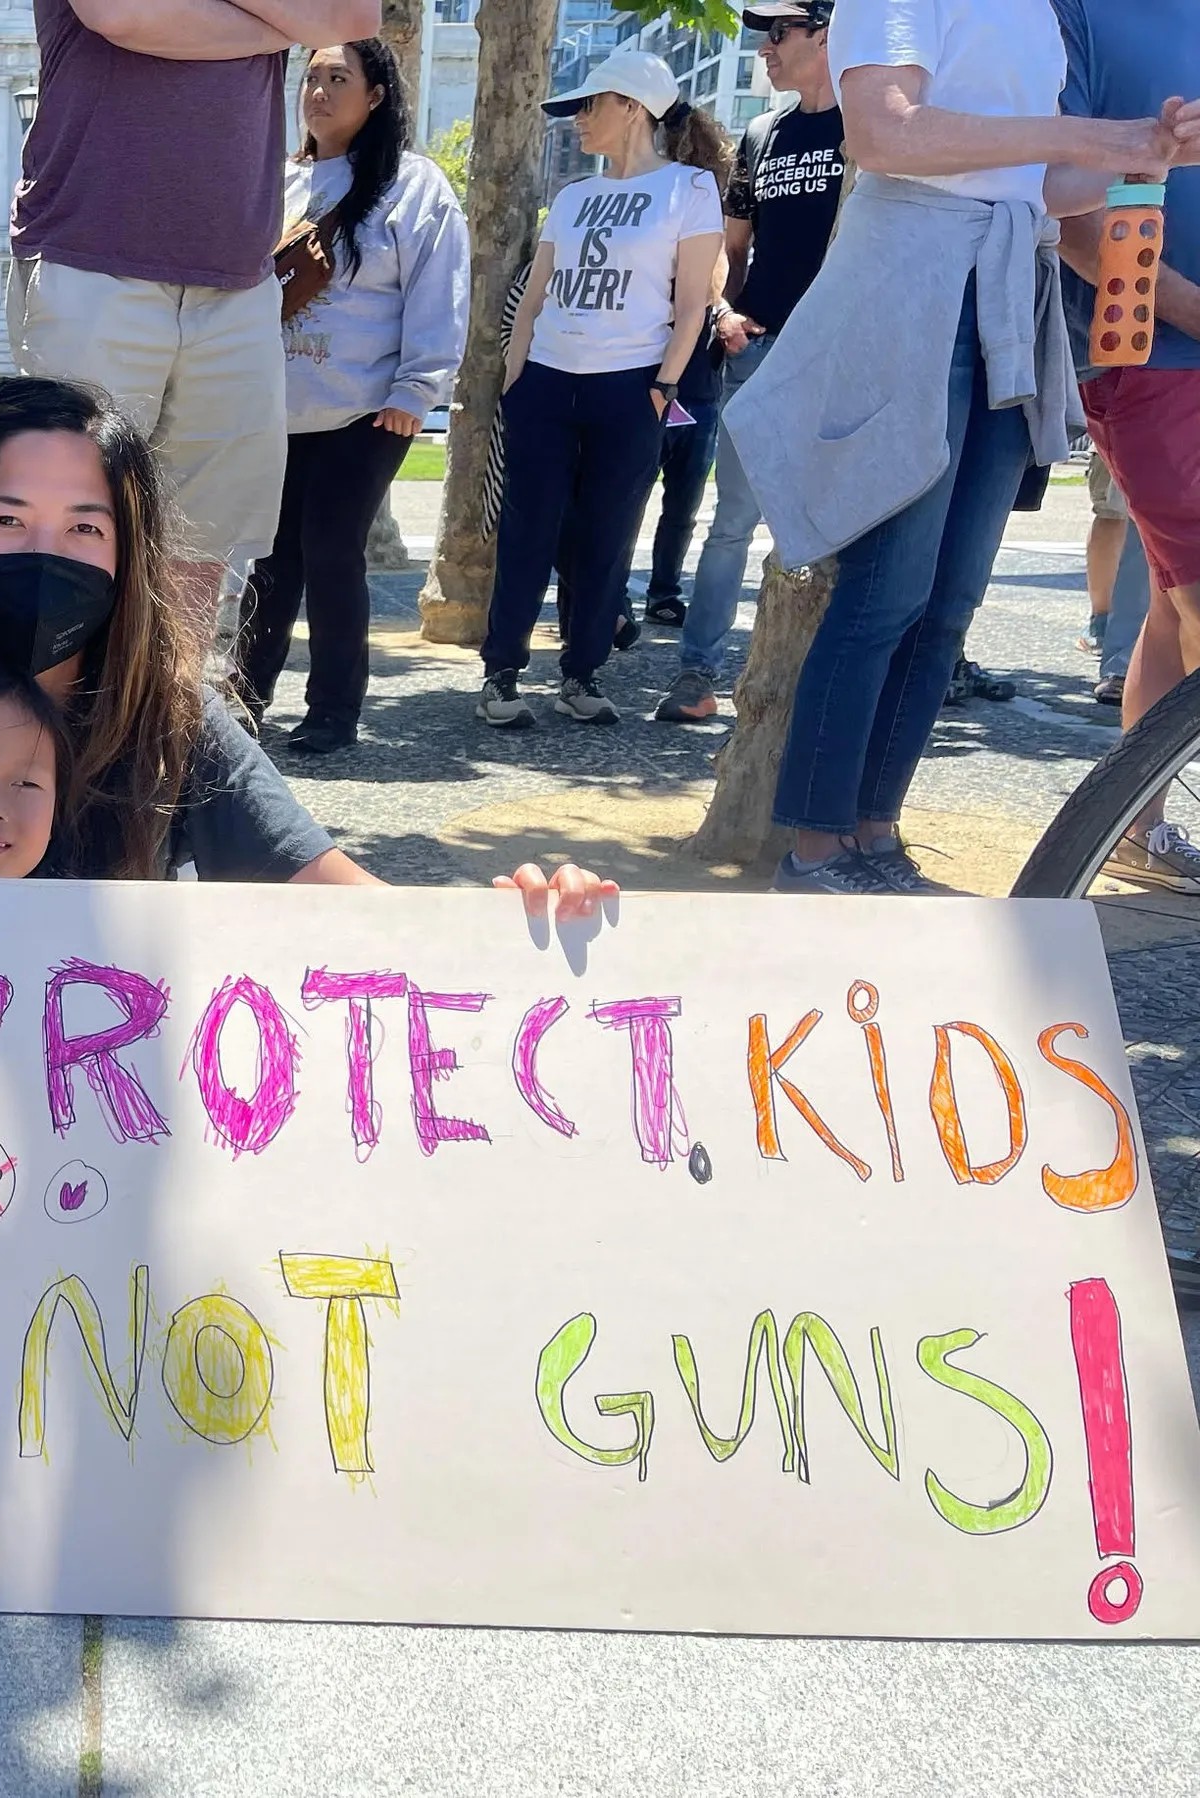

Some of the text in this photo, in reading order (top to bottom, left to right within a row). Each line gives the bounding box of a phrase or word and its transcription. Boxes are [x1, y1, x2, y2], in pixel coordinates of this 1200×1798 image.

[799, 149, 834, 165] ARE
[804, 178, 827, 193] US
[573, 193, 652, 228] WAR
[578, 227, 612, 268] IS
[17, 1243, 401, 1496] NOT
